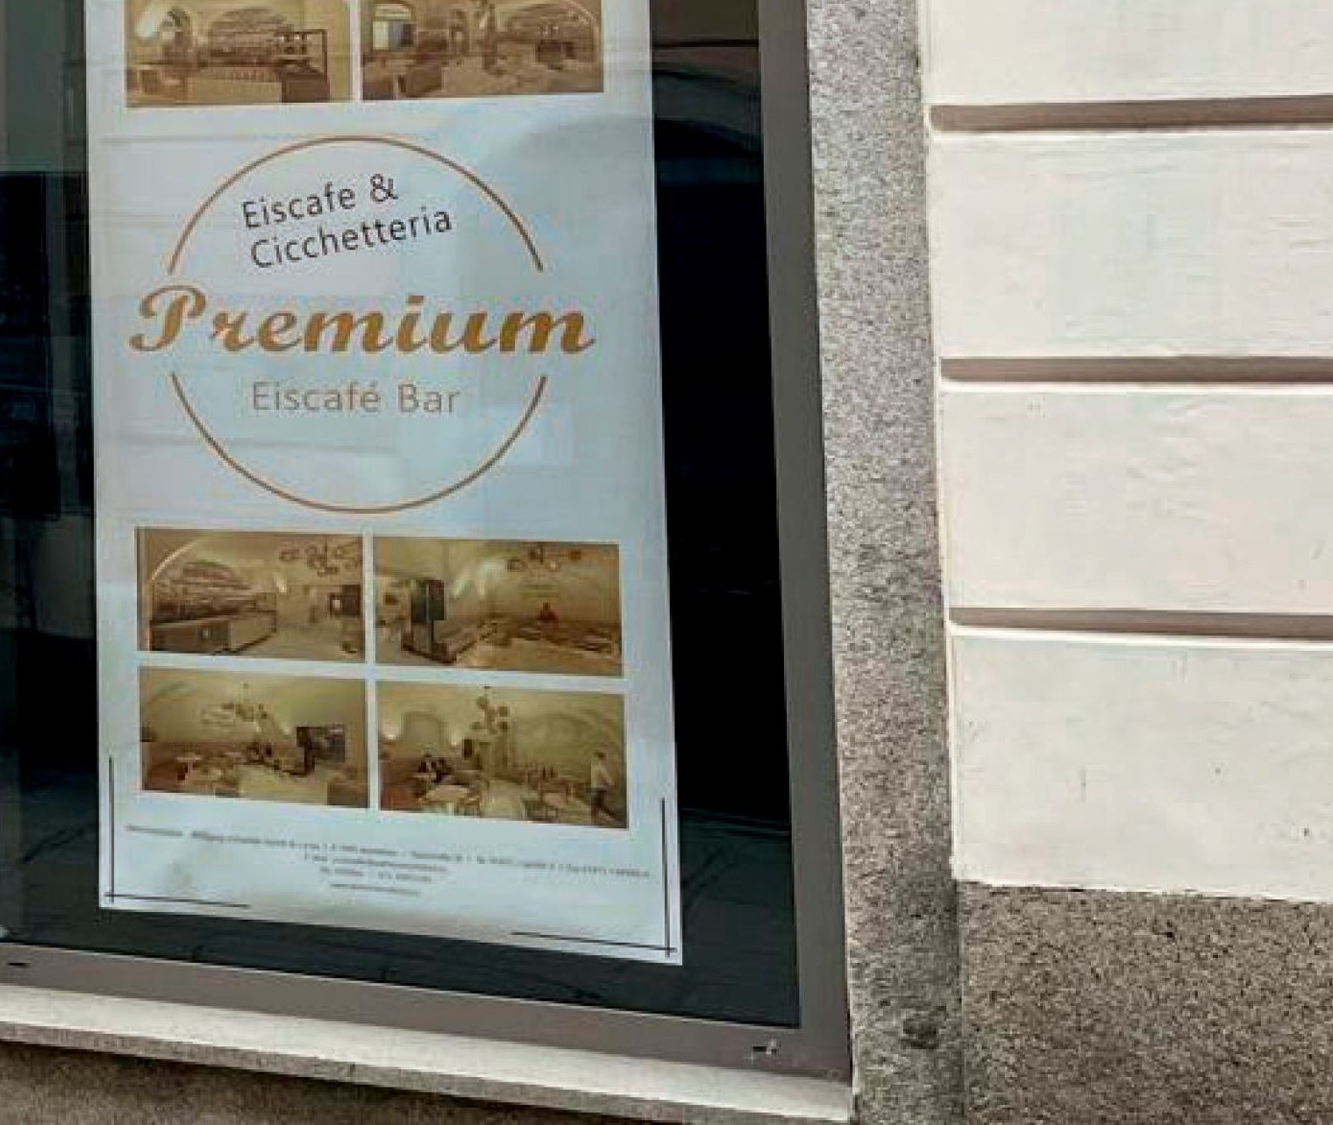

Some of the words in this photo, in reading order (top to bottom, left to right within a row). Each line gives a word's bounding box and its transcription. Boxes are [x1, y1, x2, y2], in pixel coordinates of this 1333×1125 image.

[242, 179, 356, 230] Eiscafe
[368, 173, 399, 204] &
[250, 206, 454, 270] Cicchetteria
[127, 283, 597, 355] Premium
[251, 380, 382, 413] Eiscafé
[398, 383, 461, 415] Bar
